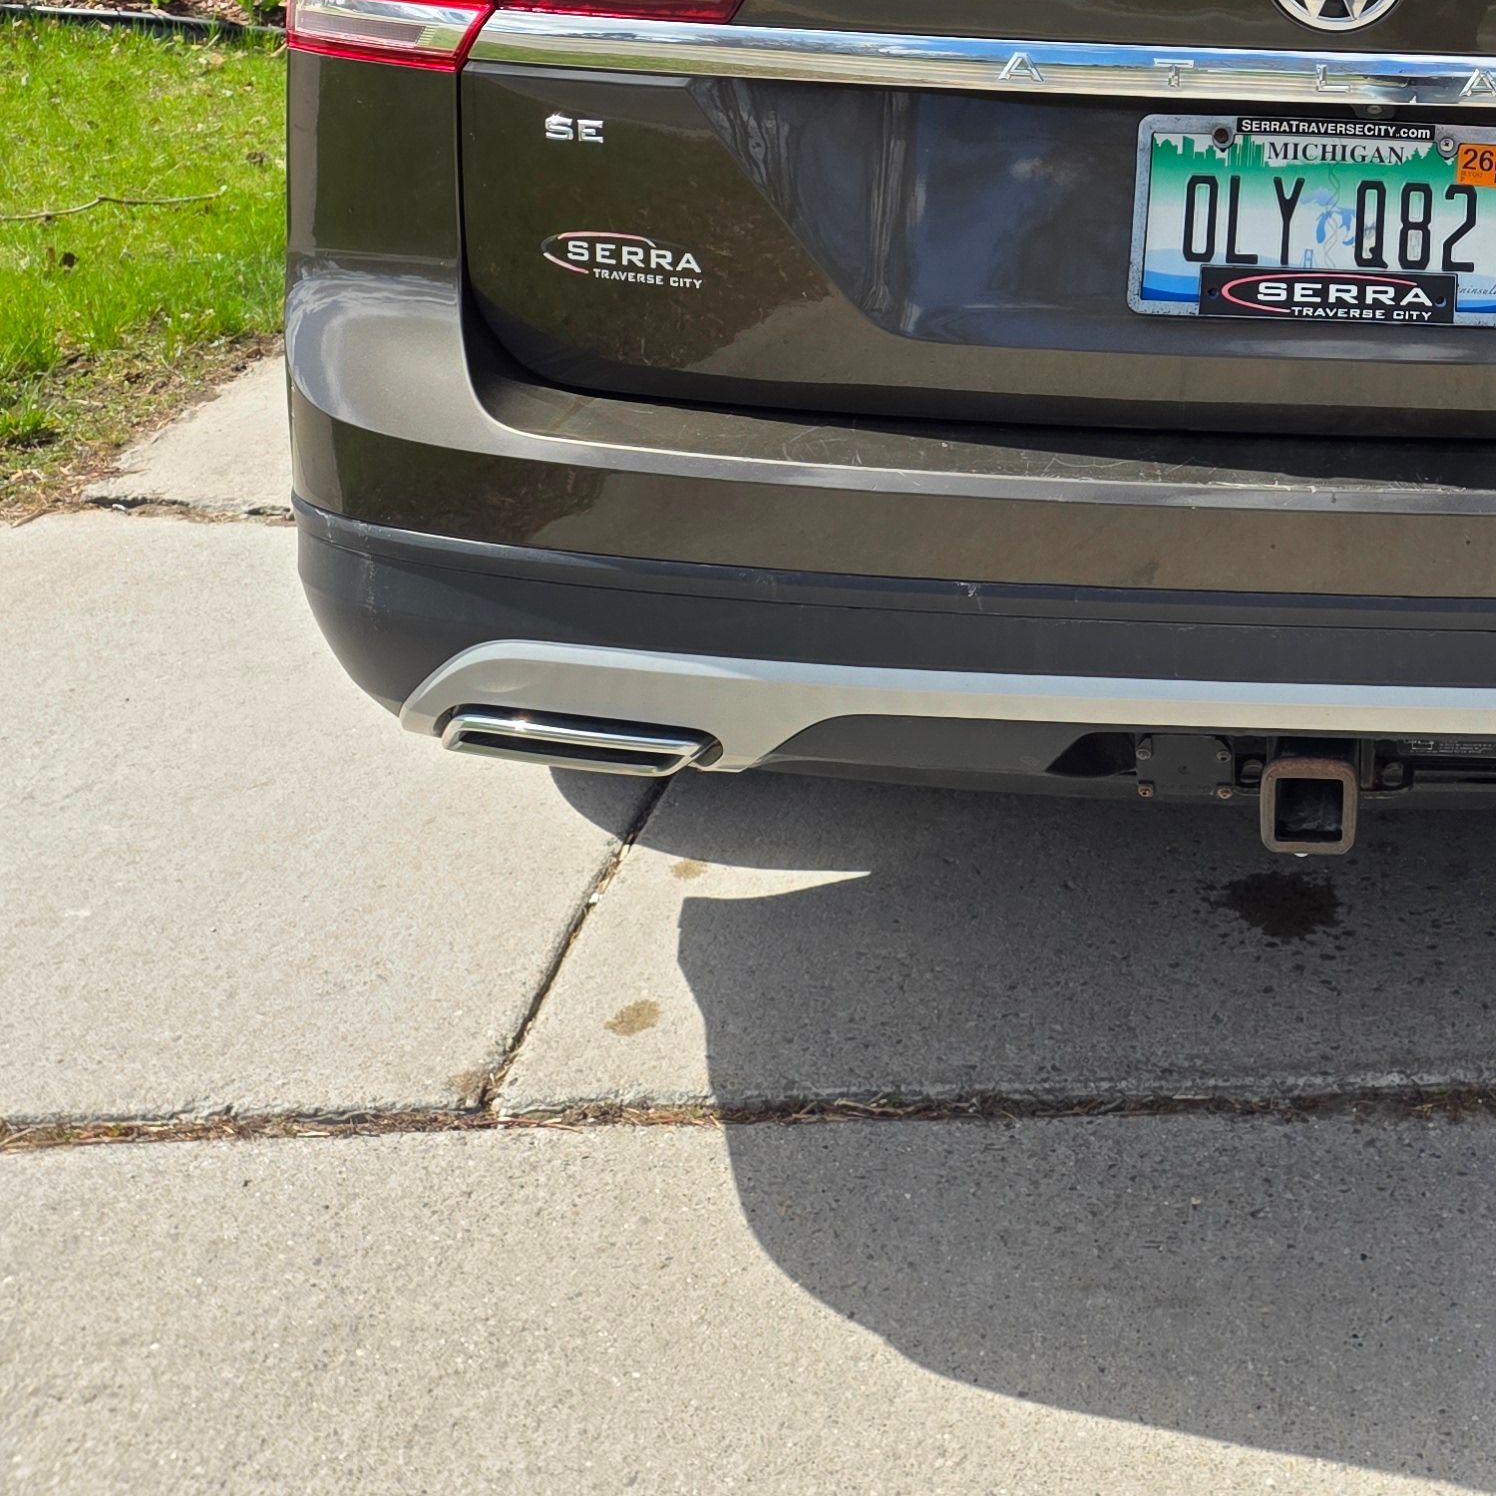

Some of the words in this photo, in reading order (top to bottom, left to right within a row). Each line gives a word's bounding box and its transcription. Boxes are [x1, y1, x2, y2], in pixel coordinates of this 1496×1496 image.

[544, 113, 604, 143] SE
[1267, 141, 1404, 165] MICHIGAN
[1462, 148, 1494, 172] 26
[1354, 179, 1478, 273] Q82
[566, 240, 702, 273] SERRA
[592, 267, 664, 286] TRAVERSE
[669, 276, 703, 289] CITY
[1257, 281, 1433, 307] SERRA
[1291, 306, 1386, 319] TRAVERSE
[1392, 309, 1432, 321] CITY
